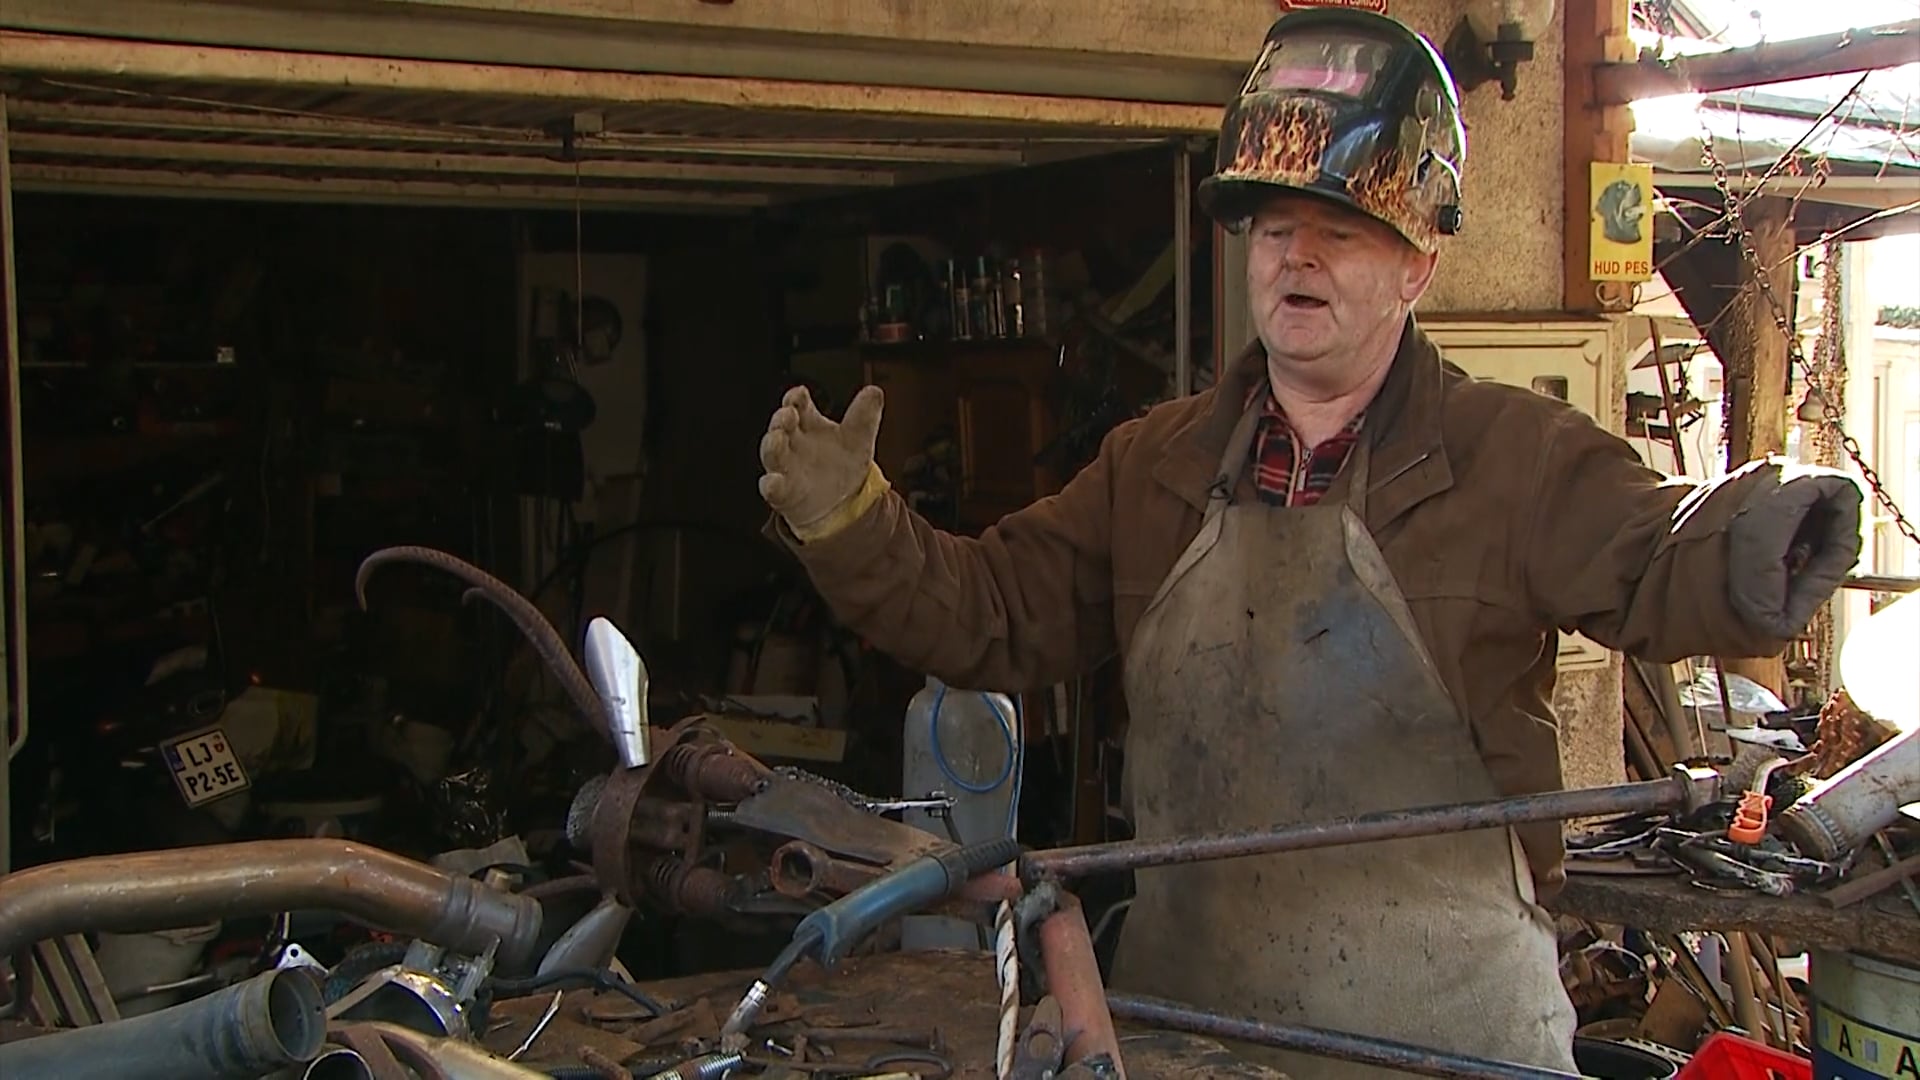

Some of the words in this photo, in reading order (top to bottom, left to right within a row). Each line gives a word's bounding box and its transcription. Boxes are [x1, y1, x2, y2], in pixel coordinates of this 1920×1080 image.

[1594, 261, 1620, 275] HUD
[1625, 261, 1649, 275] PES
[185, 743, 213, 767] LJ
[1839, 1023, 1855, 1059] A
